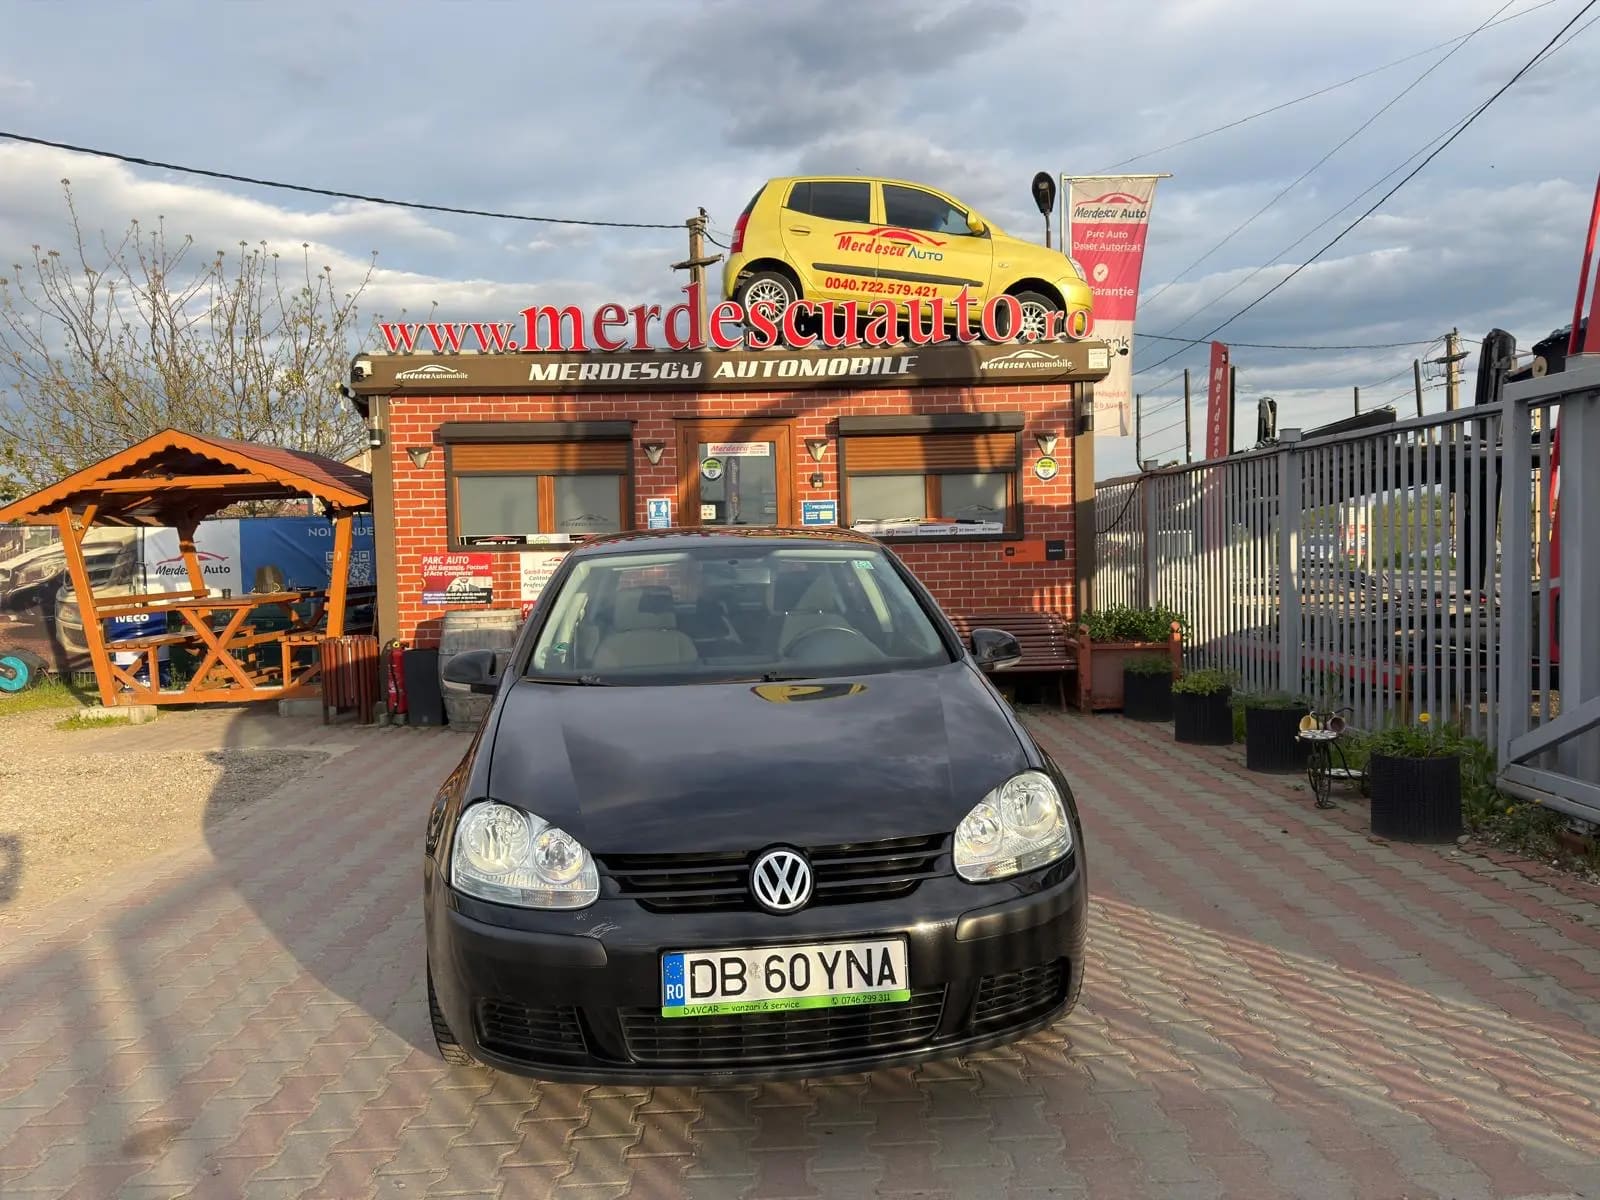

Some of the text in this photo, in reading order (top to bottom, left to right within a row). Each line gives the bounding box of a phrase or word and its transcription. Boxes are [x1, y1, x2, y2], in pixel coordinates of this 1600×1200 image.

[1074, 206, 1147, 219] Merdescu Auto
[1106, 230, 1128, 239] Auto
[838, 235, 906, 257] Merdescu
[825, 276, 938, 297] 0040.722.579.421
[713, 355, 919, 379] AUTOMOBILE
[308, 527, 331, 537] NOI
[423, 556, 469, 564] PARC AUTO
[204, 565, 231, 575] Auto
[115, 613, 150, 623] IVECO
[690, 947, 897, 998] DB 60 YNA
[666, 984, 684, 1000] RO
[841, 995, 861, 1005] 0746
[876, 993, 891, 1002] 311
[683, 1005, 719, 1014] DAVCAR
[771, 1001, 800, 1009] service
